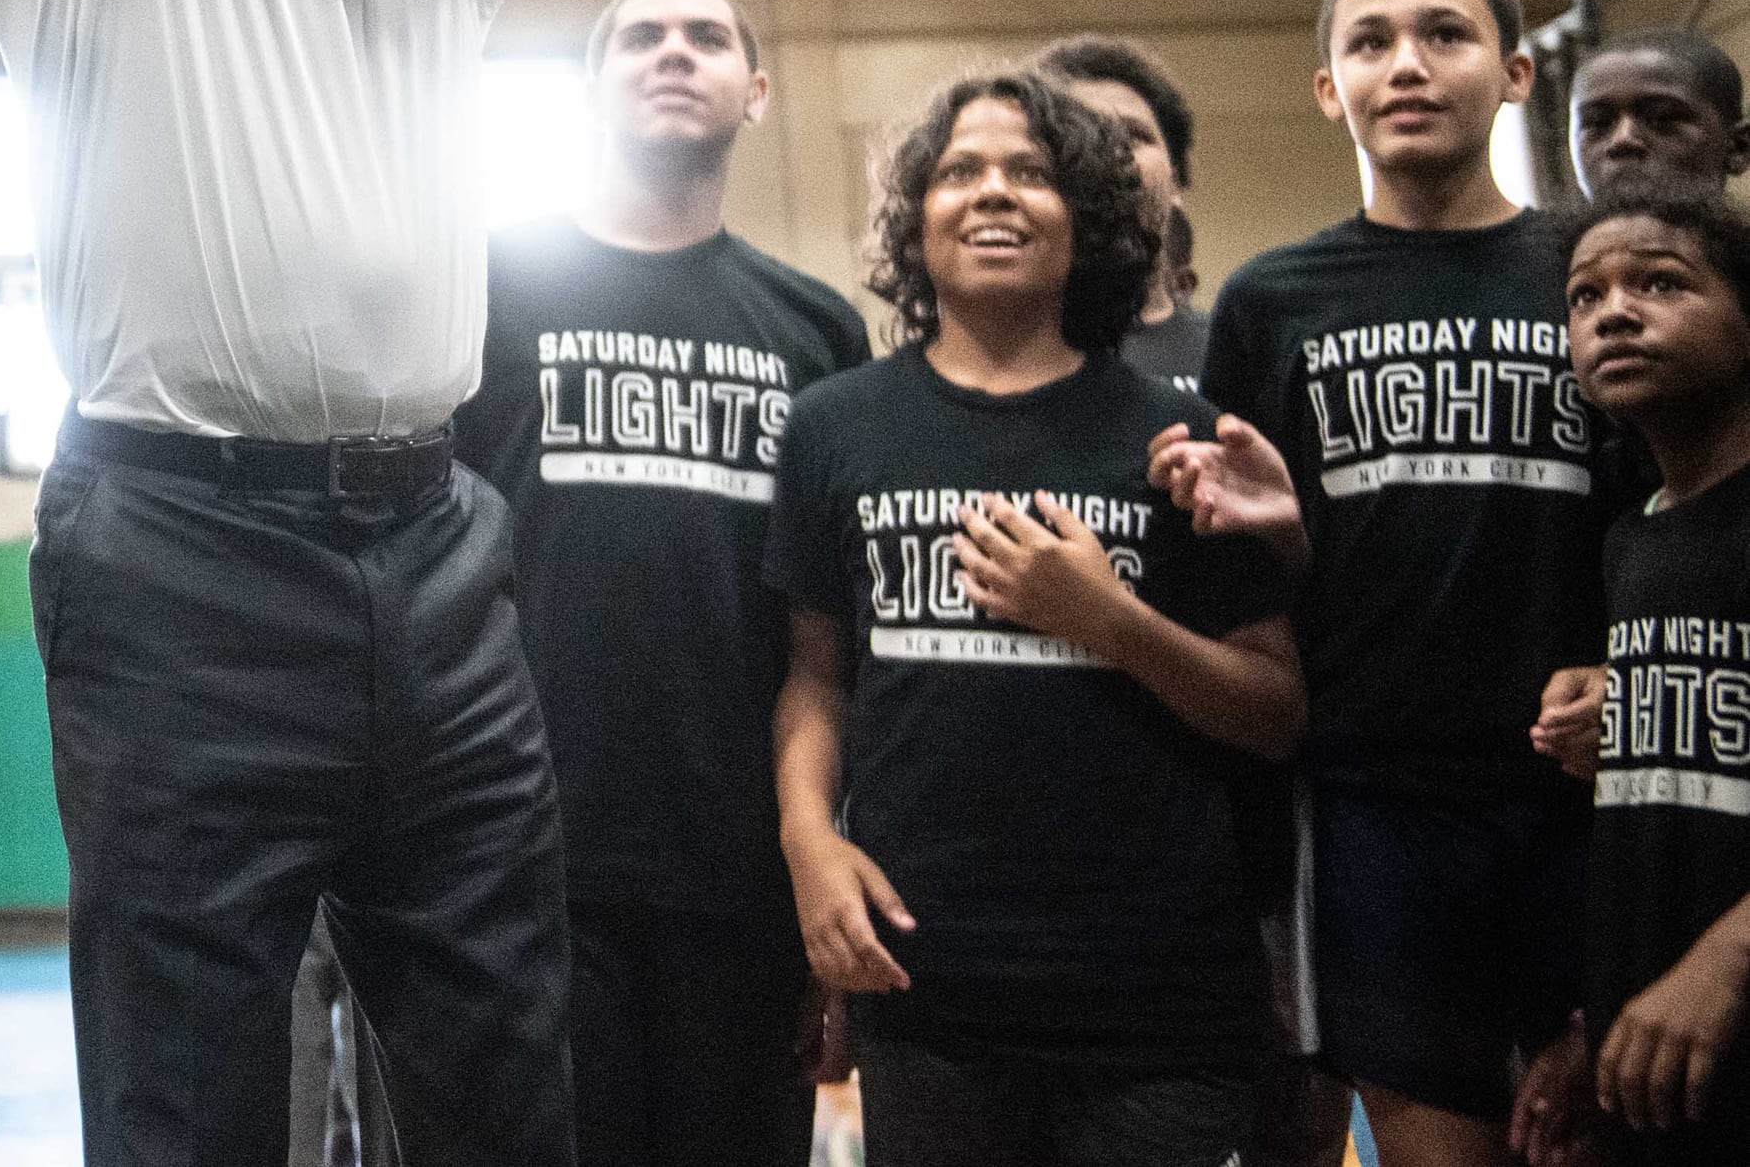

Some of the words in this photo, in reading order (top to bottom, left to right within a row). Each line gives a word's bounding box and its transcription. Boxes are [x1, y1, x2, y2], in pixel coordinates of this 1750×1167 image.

[538, 330, 693, 373] SATURDAY
[1303, 318, 1476, 374] SATURDAY
[1491, 318, 1571, 359] NIGH
[540, 367, 792, 466] LIGHTS
[1308, 359, 1590, 462] LIGHTS
[1409, 459, 1470, 479] YORK
[1490, 461, 1546, 483] CITY
[905, 636, 941, 653] NEW
[958, 637, 1019, 656] YORK
[1664, 616, 1750, 661] NIGHT
